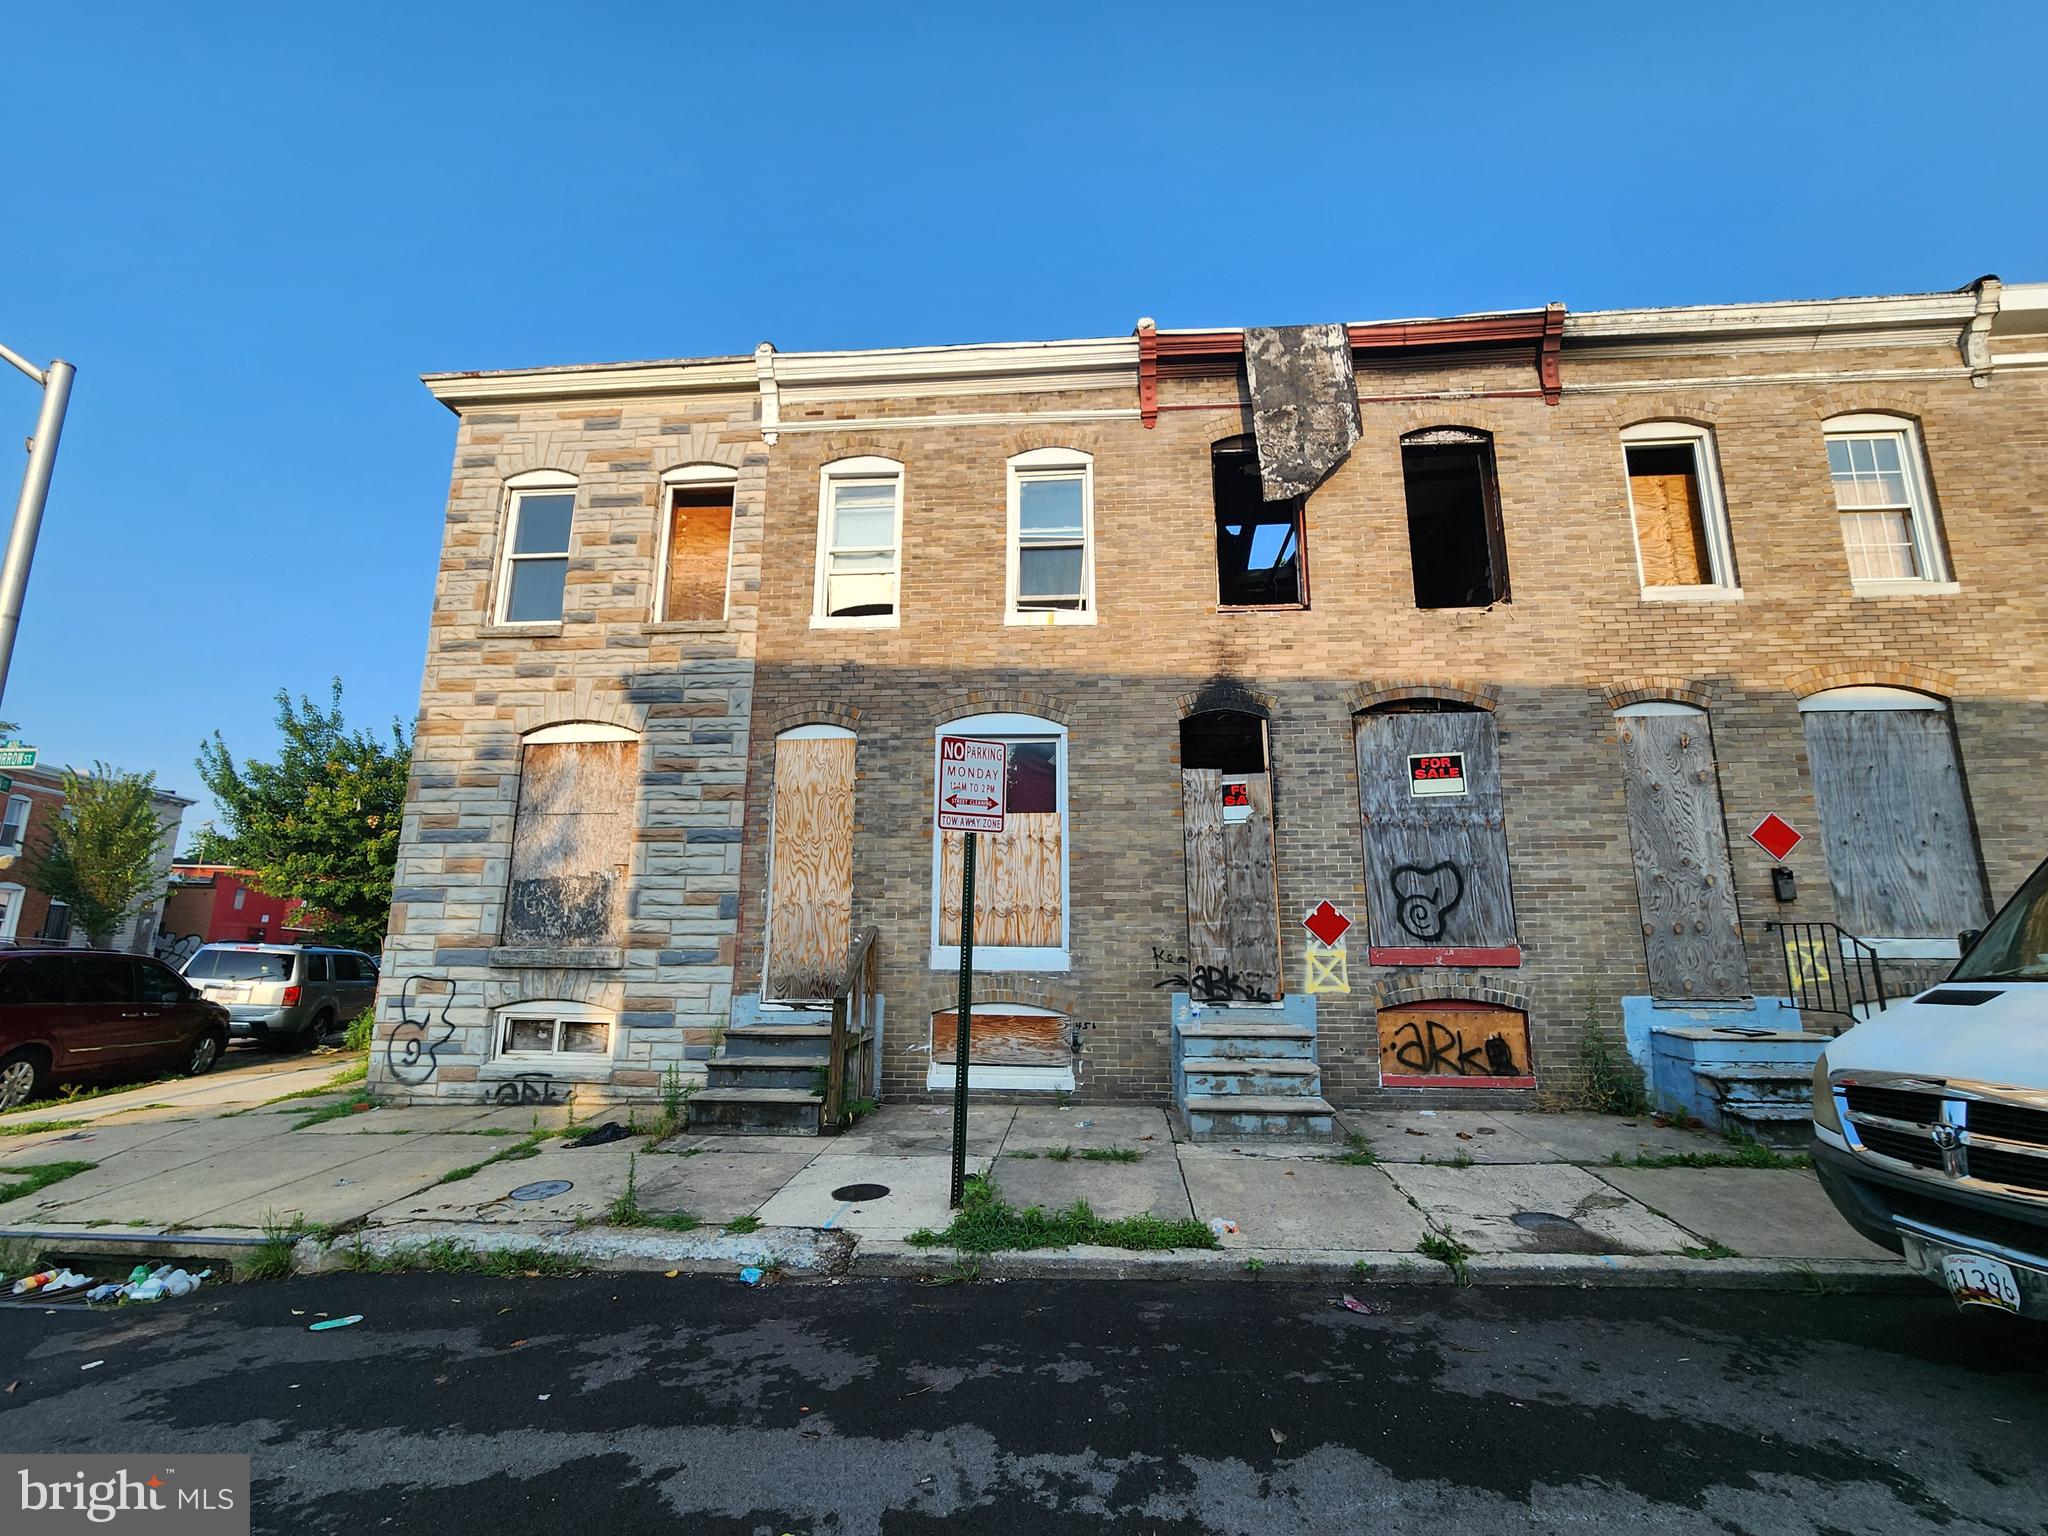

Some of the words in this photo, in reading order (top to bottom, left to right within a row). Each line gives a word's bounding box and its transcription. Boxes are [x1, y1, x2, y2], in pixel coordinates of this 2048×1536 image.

[944, 741, 965, 759] NO
[966, 746, 1002, 761] PARKING
[0, 752, 24, 766] RROW
[1421, 757, 1451, 768] FOR
[947, 765, 999, 780] MONDAY
[1414, 767, 1460, 779] SALE
[970, 783, 979, 792] TO
[951, 797, 968, 805] STREET
[969, 799, 993, 807] CLEANING
[942, 815, 958, 826] TOW
[959, 817, 980, 828] AWAY
[982, 819, 1001, 829] ZONE
